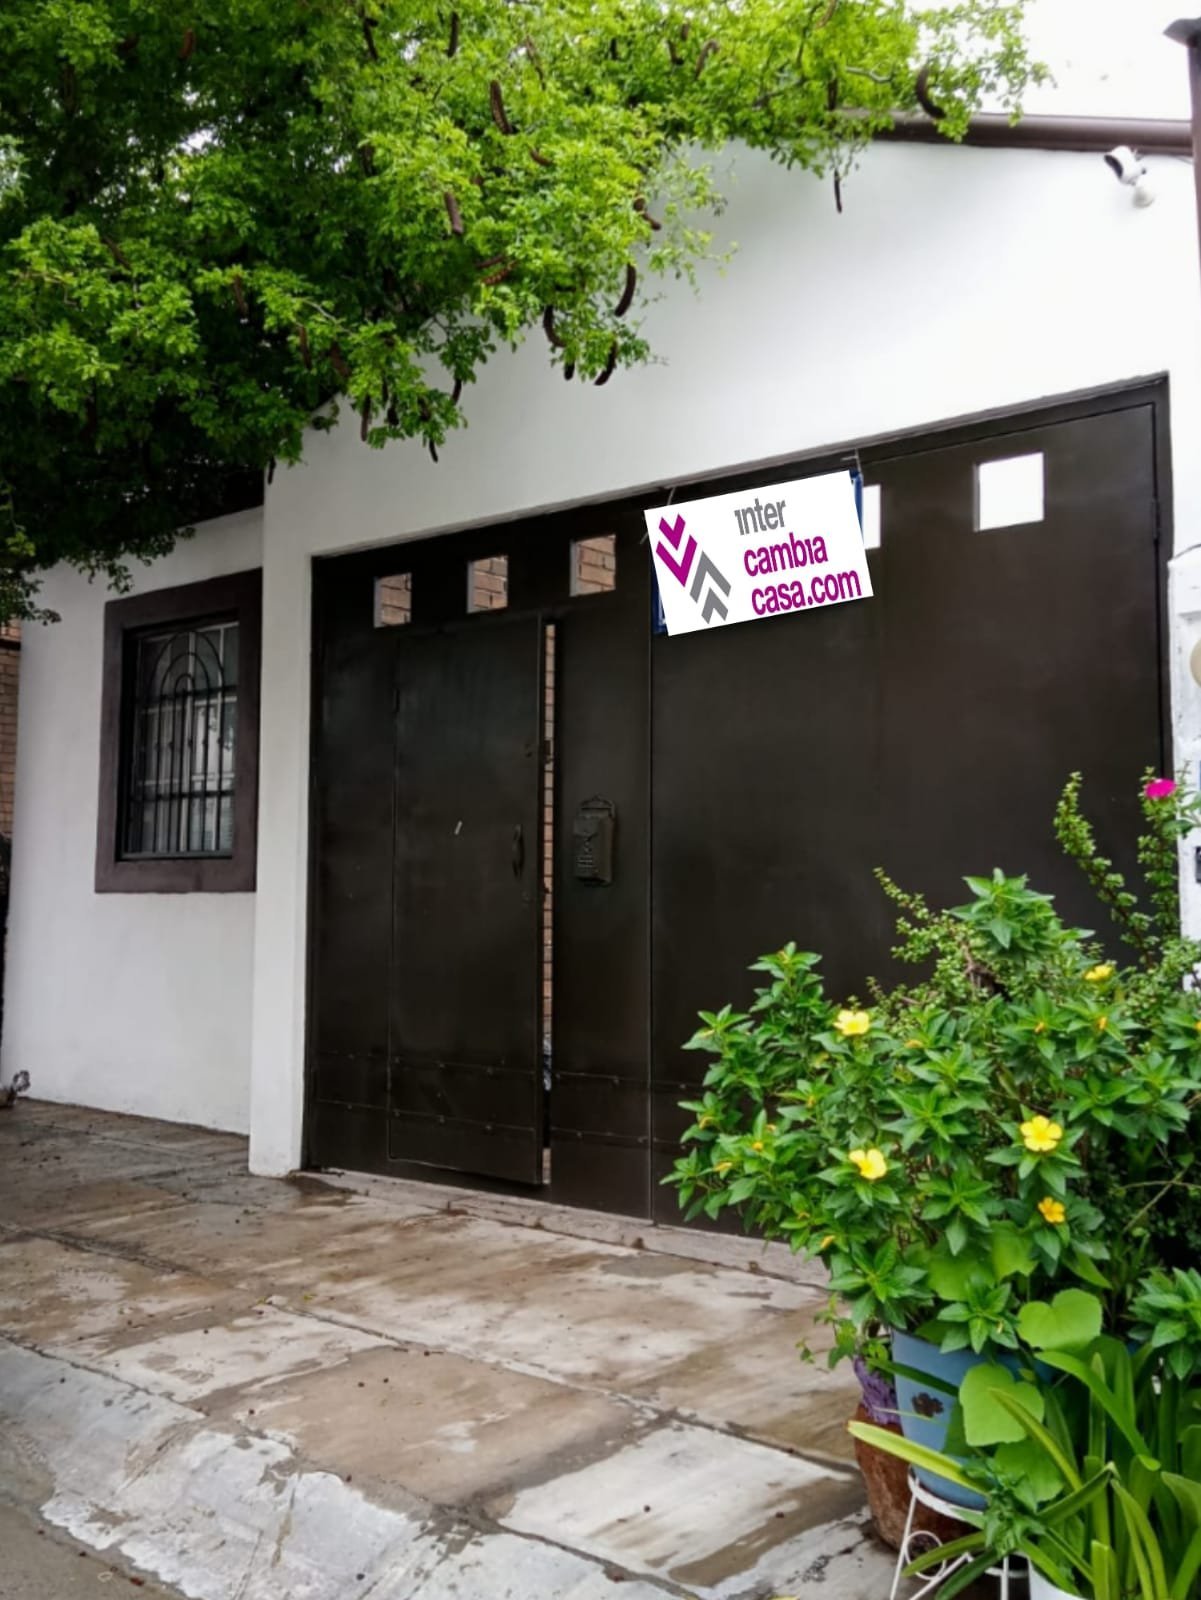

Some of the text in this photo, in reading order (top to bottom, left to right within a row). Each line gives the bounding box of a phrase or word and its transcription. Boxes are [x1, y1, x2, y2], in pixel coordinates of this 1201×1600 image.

[734, 498, 786, 535] inter
[743, 532, 828, 577] cambia
[751, 570, 862, 616] casa.com
